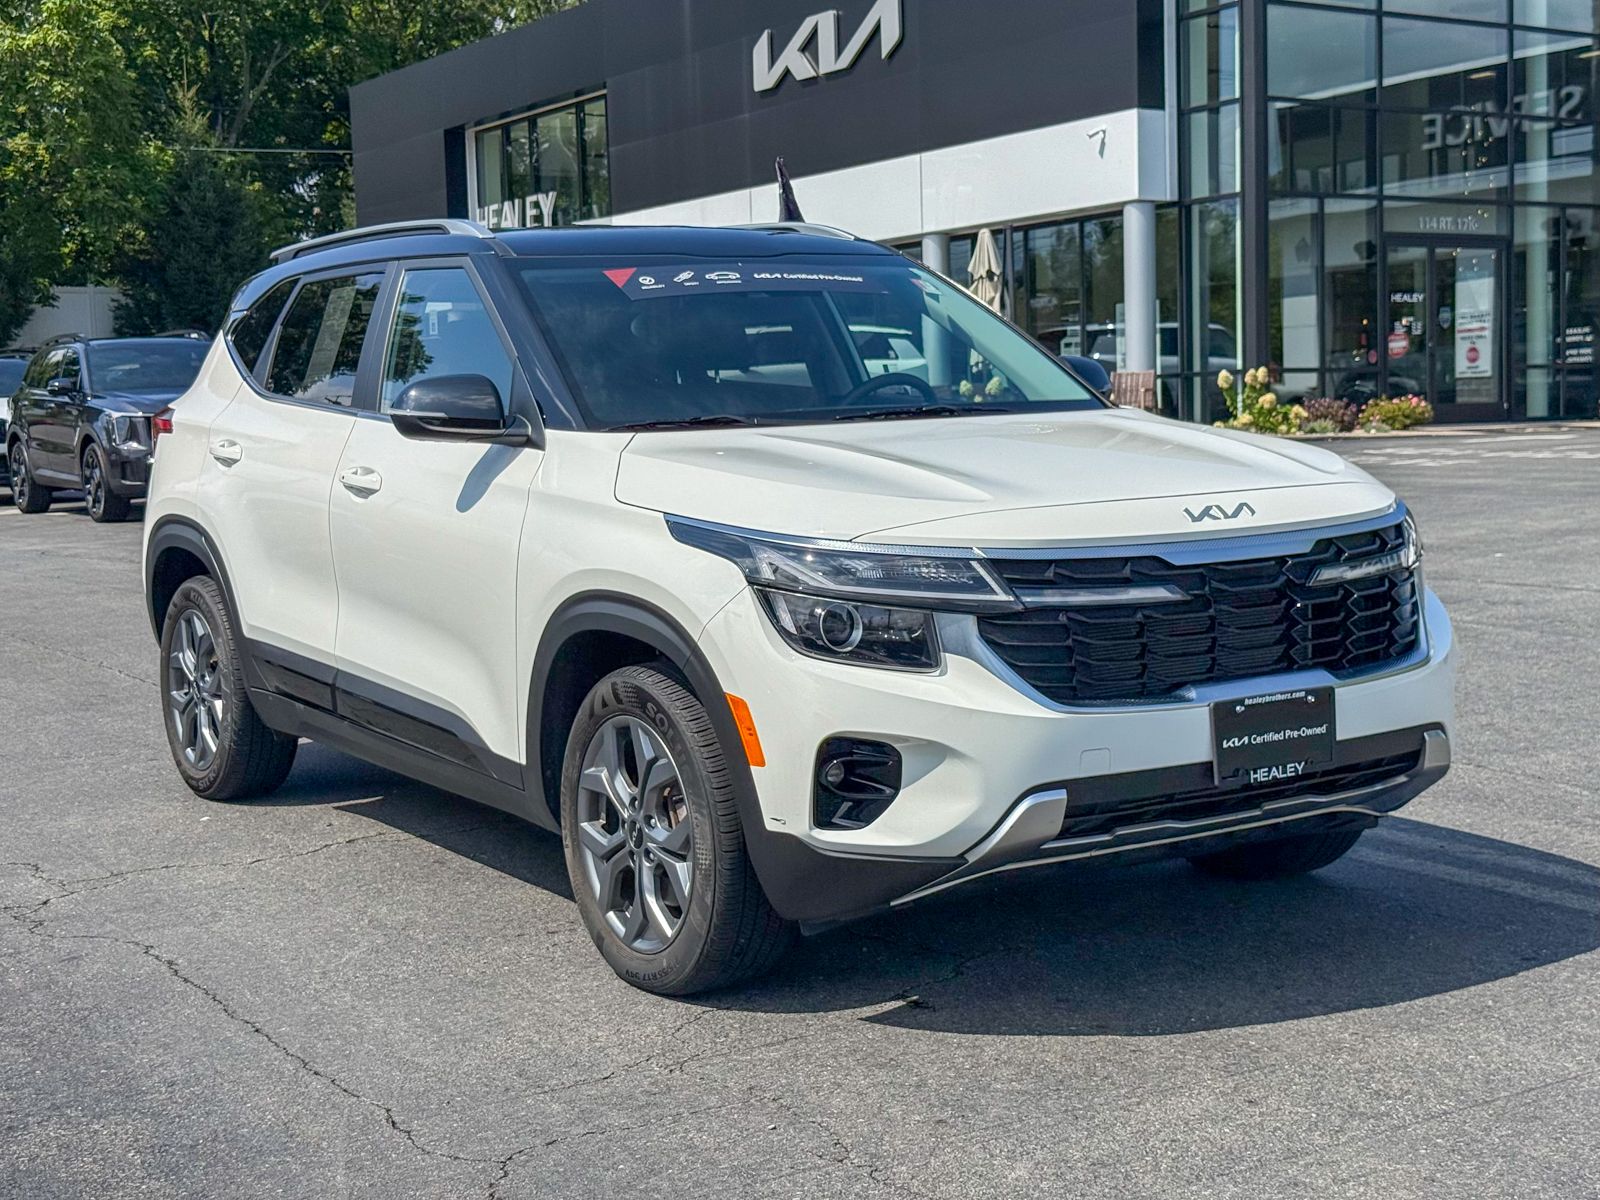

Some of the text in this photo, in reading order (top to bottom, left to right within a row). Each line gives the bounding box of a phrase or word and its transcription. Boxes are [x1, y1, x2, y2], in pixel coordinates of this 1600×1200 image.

[752, 0, 903, 93] KIA
[1391, 292, 1424, 303] HEALEY
[1182, 501, 1256, 523] KIA
[1244, 691, 1306, 706] healeybrothers.com
[1222, 725, 1327, 749] KIA Certified Pre-Owned
[1250, 761, 1305, 784] HEALEY
